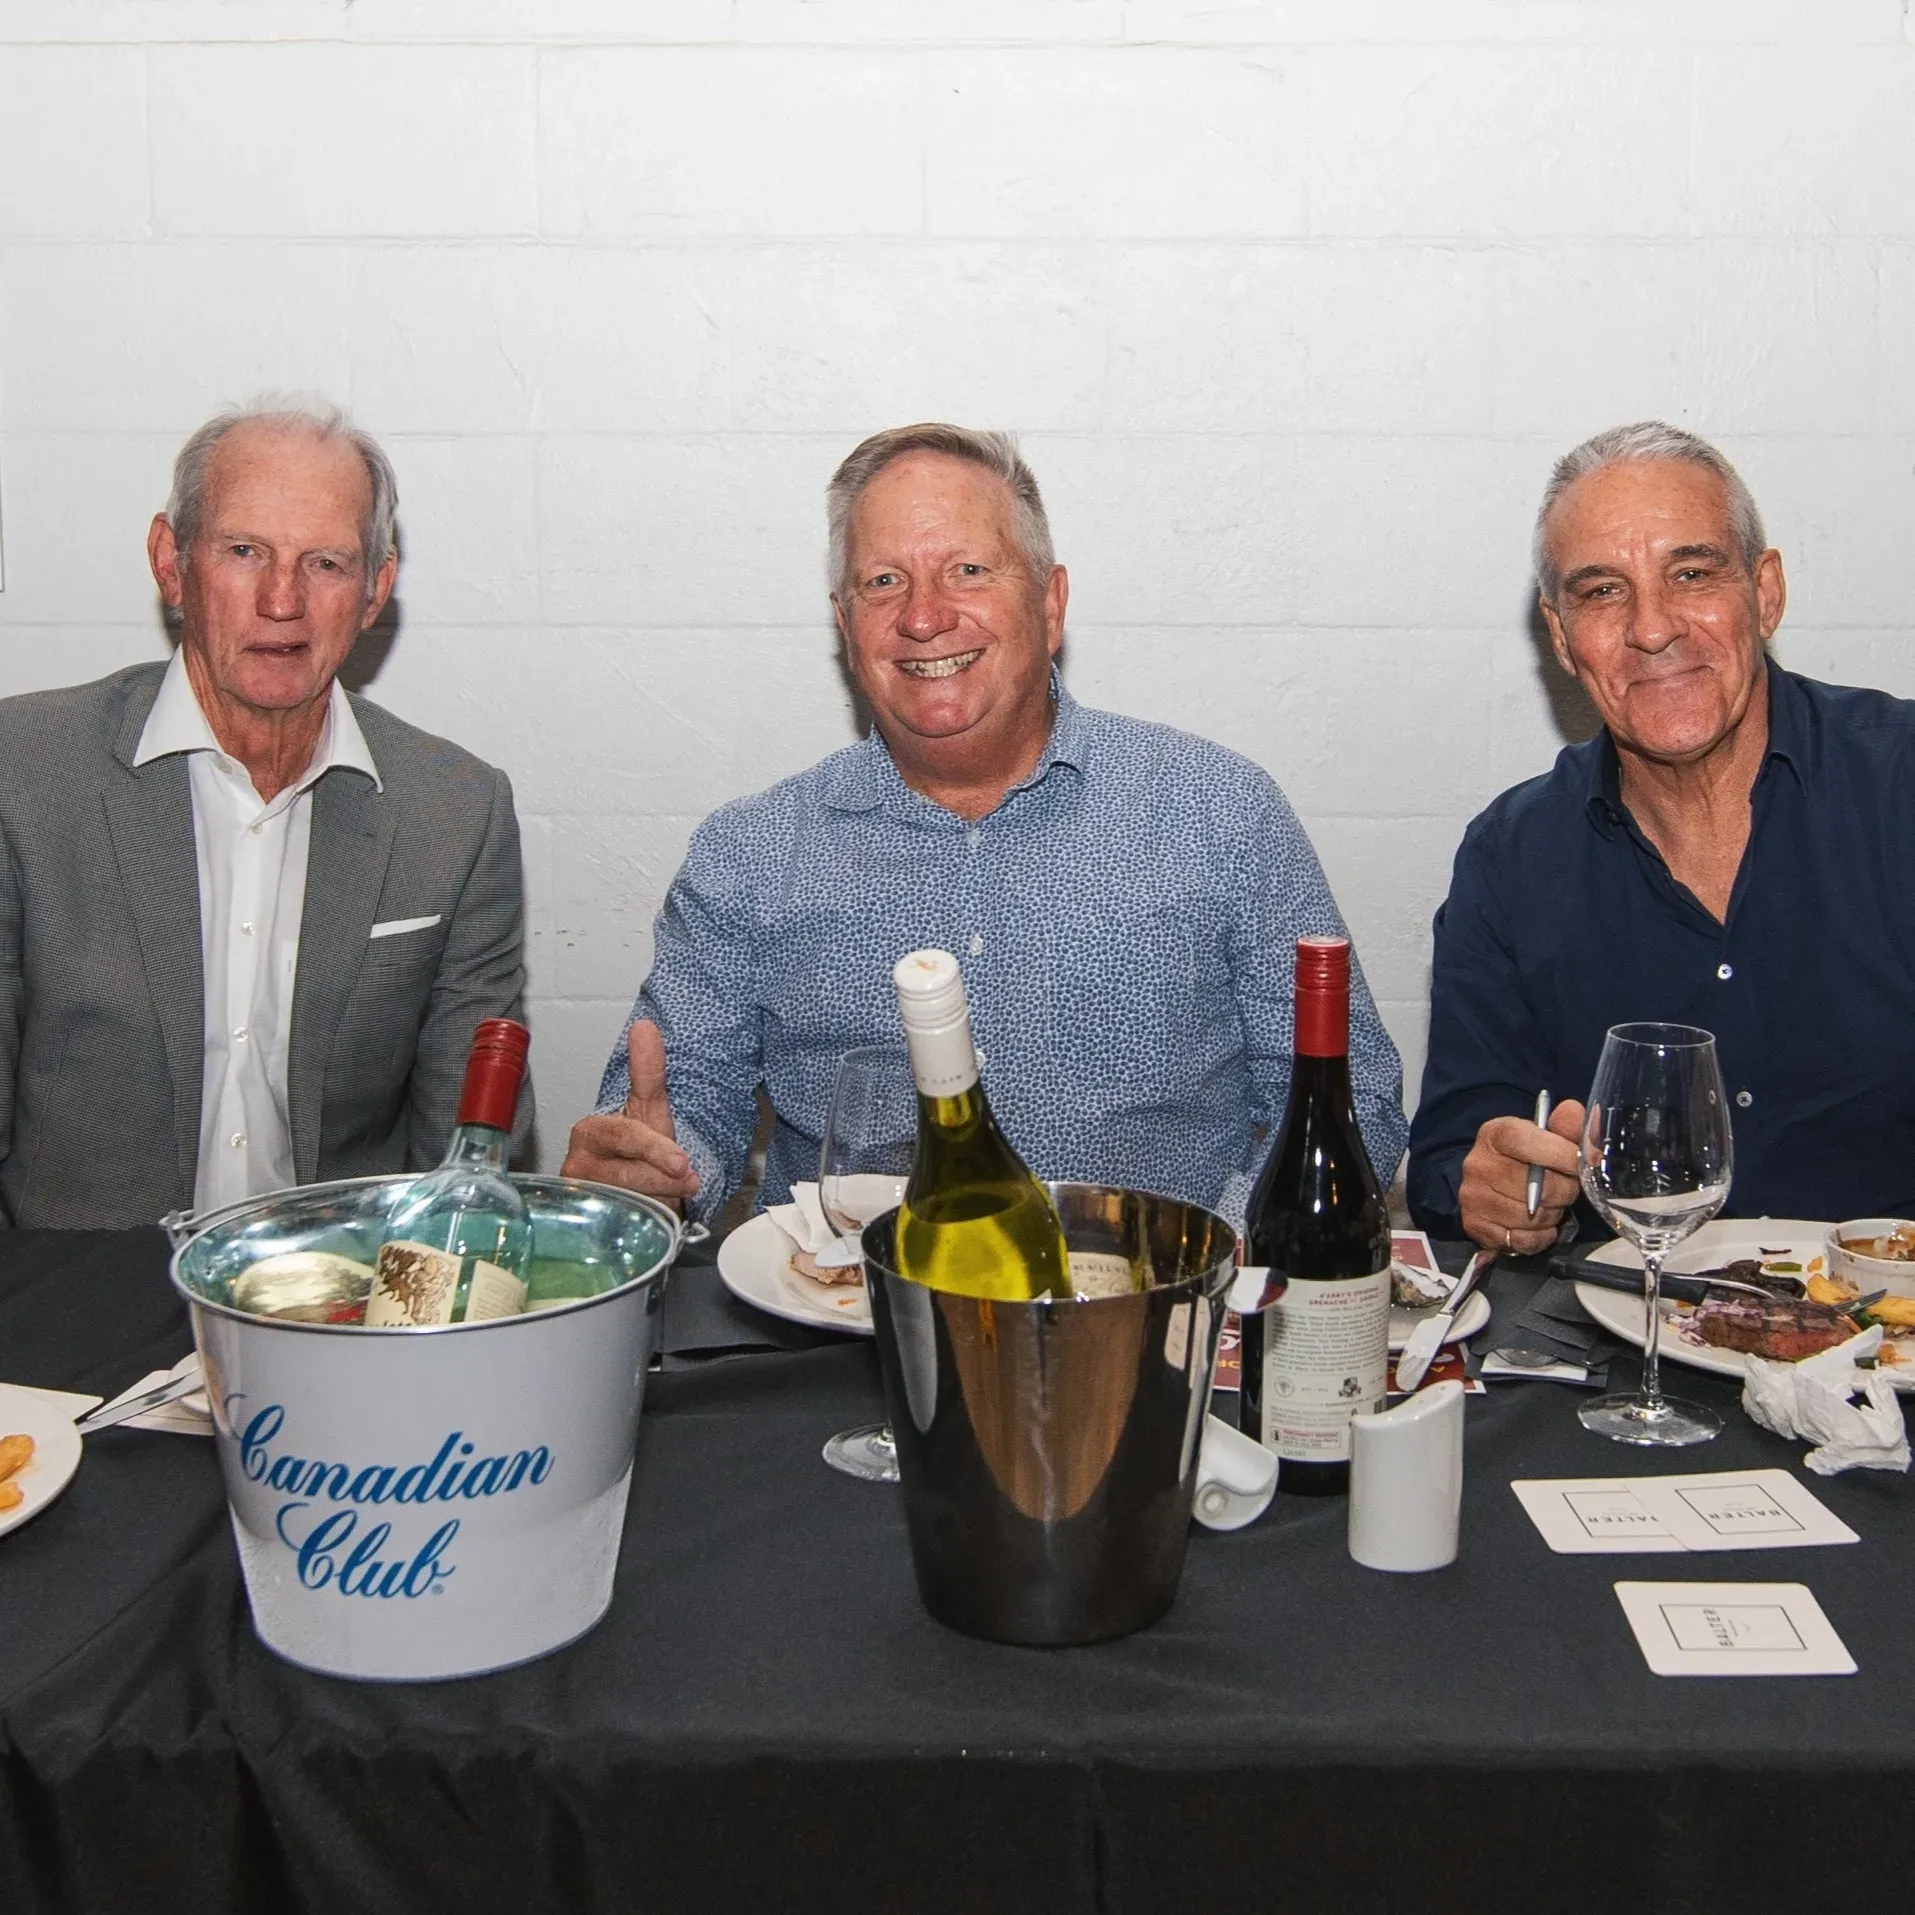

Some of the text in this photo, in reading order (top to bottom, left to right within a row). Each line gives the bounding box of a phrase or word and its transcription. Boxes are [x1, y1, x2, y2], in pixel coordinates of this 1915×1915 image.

[226, 1394, 556, 1504] Canadian
[1708, 1509, 1783, 1520] BALTER
[276, 1502, 461, 1599] Club
[1702, 1607, 1735, 1647] BALTER
